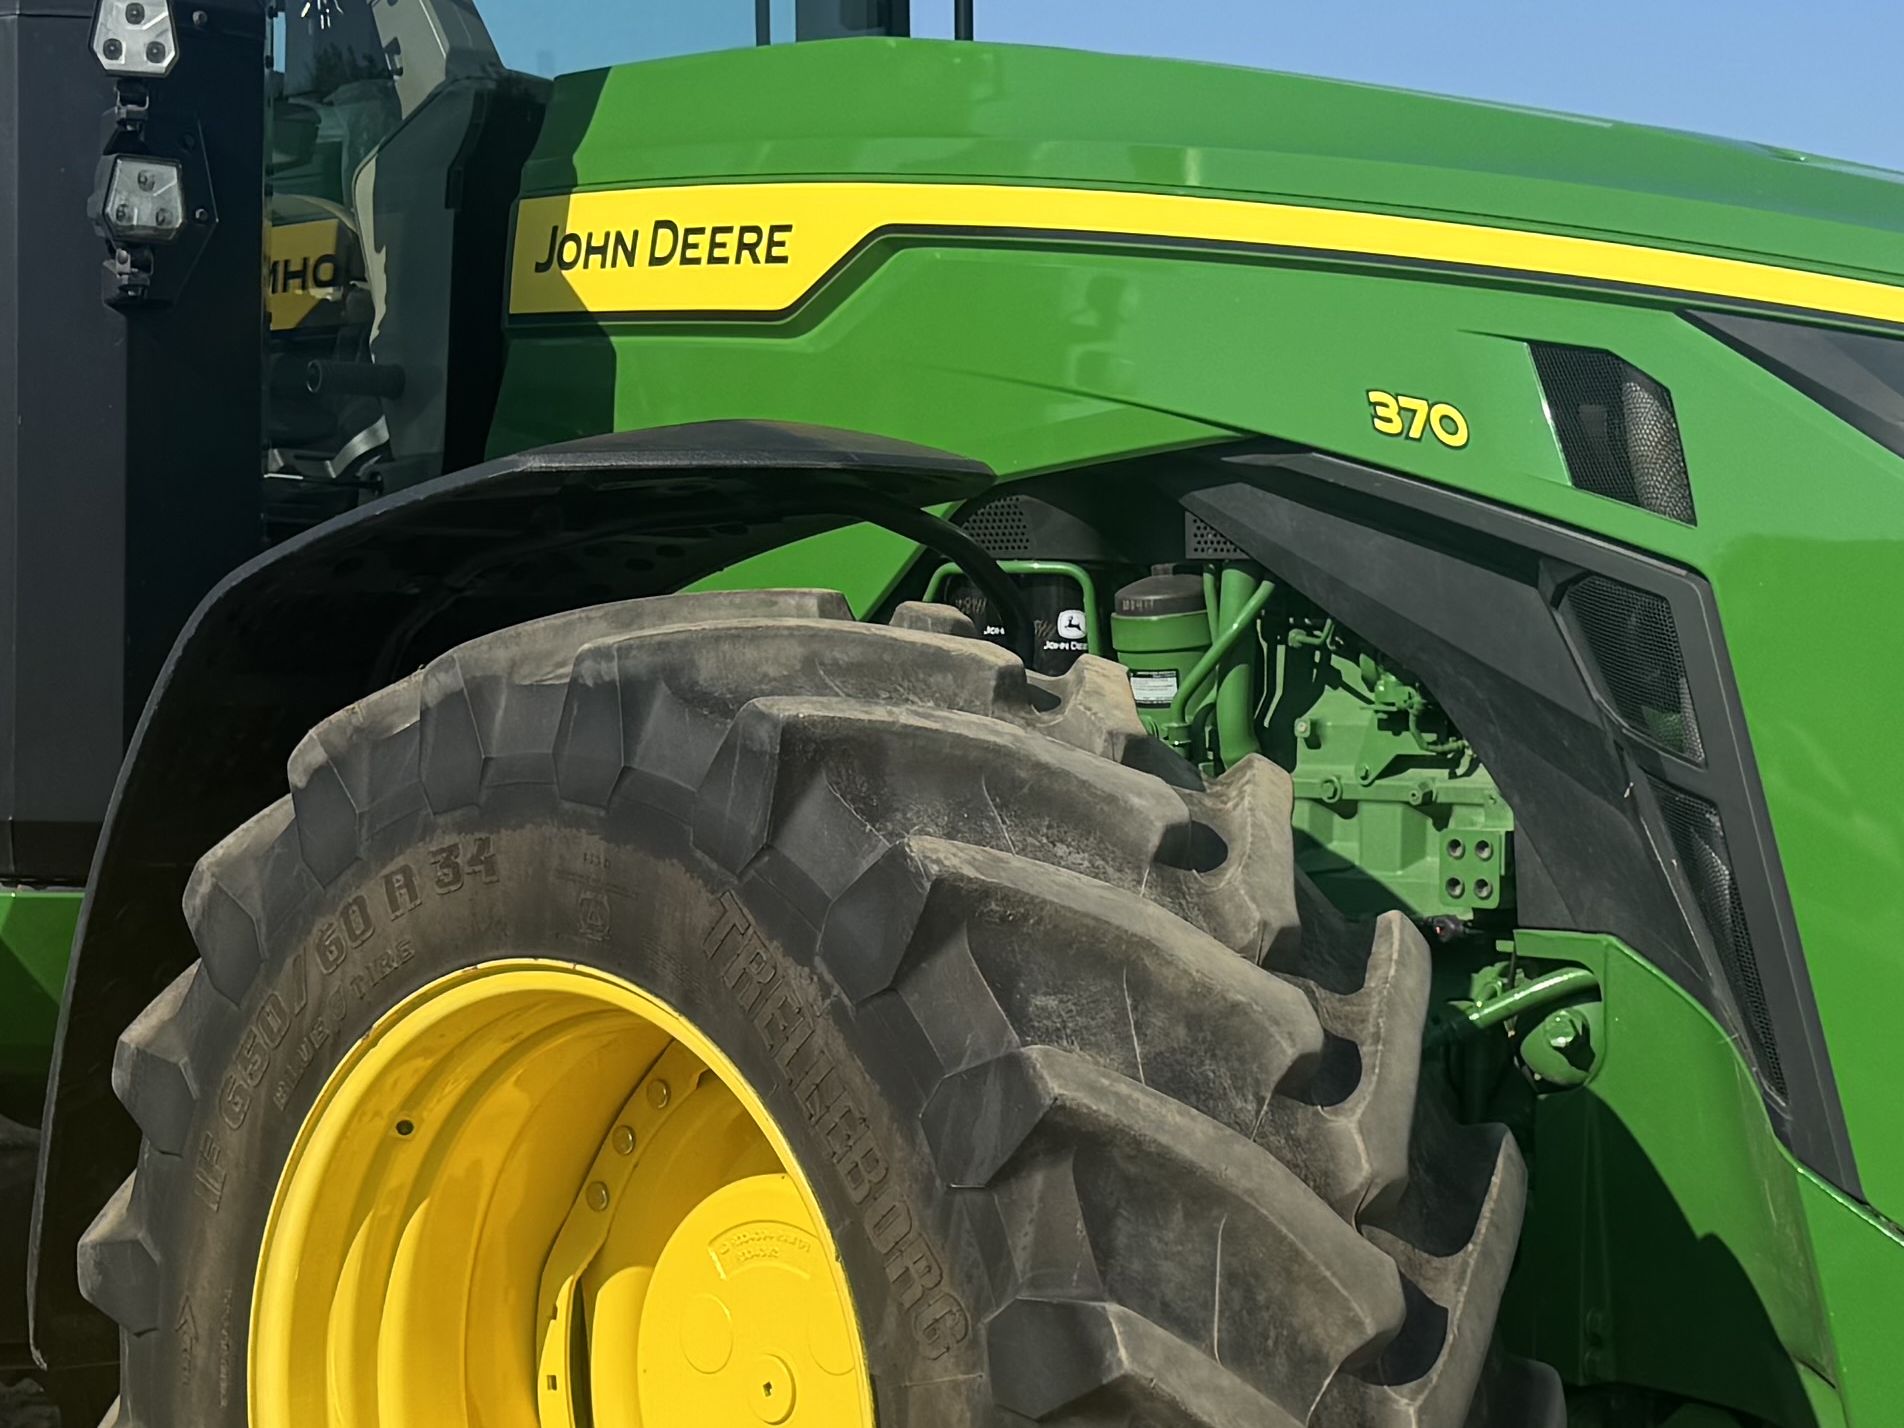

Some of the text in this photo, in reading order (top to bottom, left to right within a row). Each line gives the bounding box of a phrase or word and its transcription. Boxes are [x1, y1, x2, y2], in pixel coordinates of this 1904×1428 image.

[535, 219, 793, 273] JOHN DEERE
[1366, 389, 1469, 448] 370
[1043, 640, 1069, 650] JOHN
[430, 836, 500, 895] 34
[702, 891, 971, 1361] TRELLEBORG
